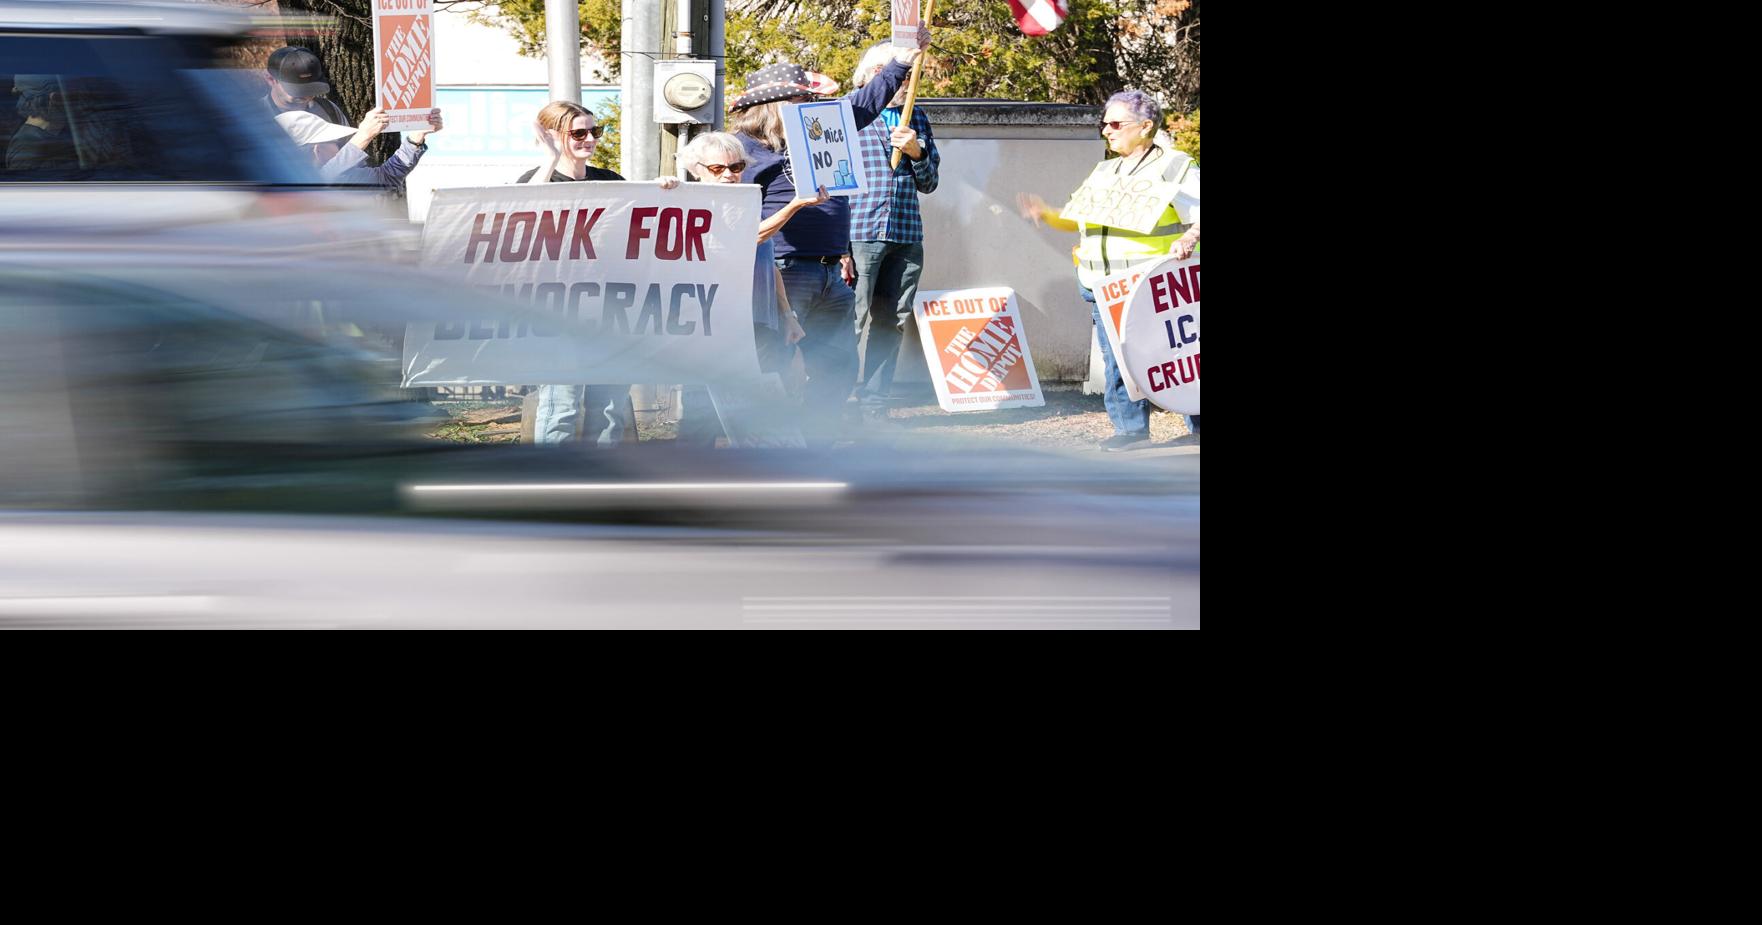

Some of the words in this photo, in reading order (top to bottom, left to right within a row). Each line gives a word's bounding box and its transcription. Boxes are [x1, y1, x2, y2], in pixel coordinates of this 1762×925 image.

[382, 15, 430, 110] HOME
[385, 24, 406, 64] THE
[401, 49, 431, 109] DEPOT
[812, 151, 833, 170] NO
[1112, 177, 1153, 193] NO
[464, 207, 606, 264] HONK
[625, 207, 713, 262] FOR
[923, 299, 951, 317] ICE
[953, 298, 984, 315] OUT
[988, 296, 1008, 313] OF
[1102, 279, 1130, 302] ICE
[944, 326, 976, 357] THE
[1165, 314, 1200, 349] I.C
[946, 317, 1016, 393] HOME
[980, 343, 1022, 391] DEPOT
